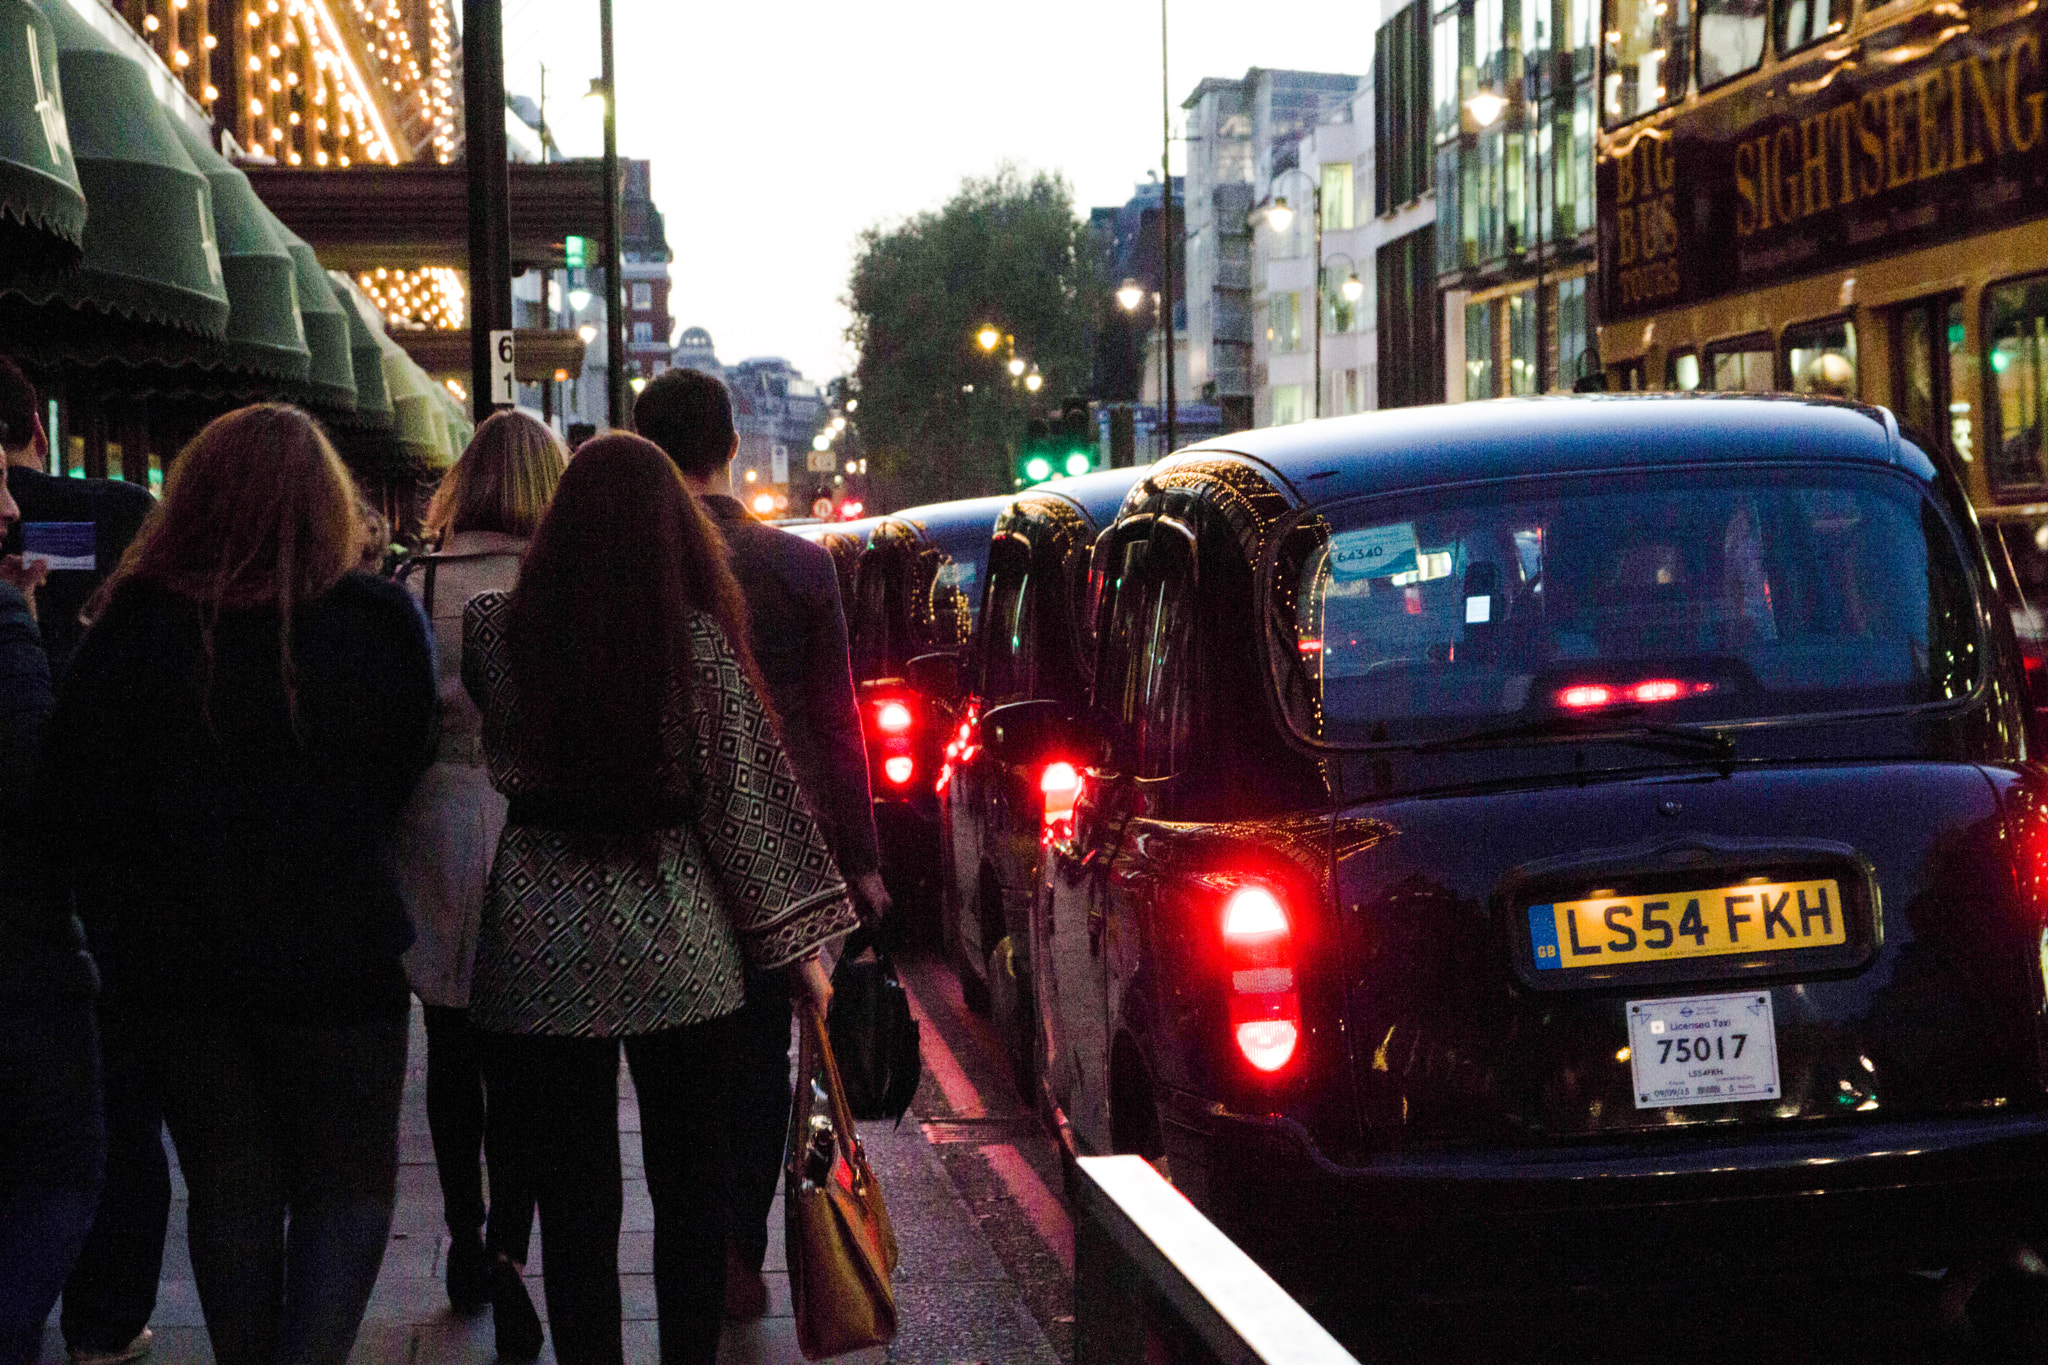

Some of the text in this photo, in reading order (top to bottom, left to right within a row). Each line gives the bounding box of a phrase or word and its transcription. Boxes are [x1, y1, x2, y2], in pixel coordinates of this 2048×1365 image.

[1735, 35, 2047, 235] SIGHTSEEING
[1617, 137, 1675, 203] BIG
[1617, 194, 1677, 265] BUS
[498, 336, 513, 363] 6
[504, 372, 512, 399] 1
[1566, 887, 1833, 956] LS54 FKH
[1537, 945, 1556, 958] GB
[1670, 1018, 1731, 1031] Licensed Taxi
[1657, 1033, 1748, 1065] 75017
